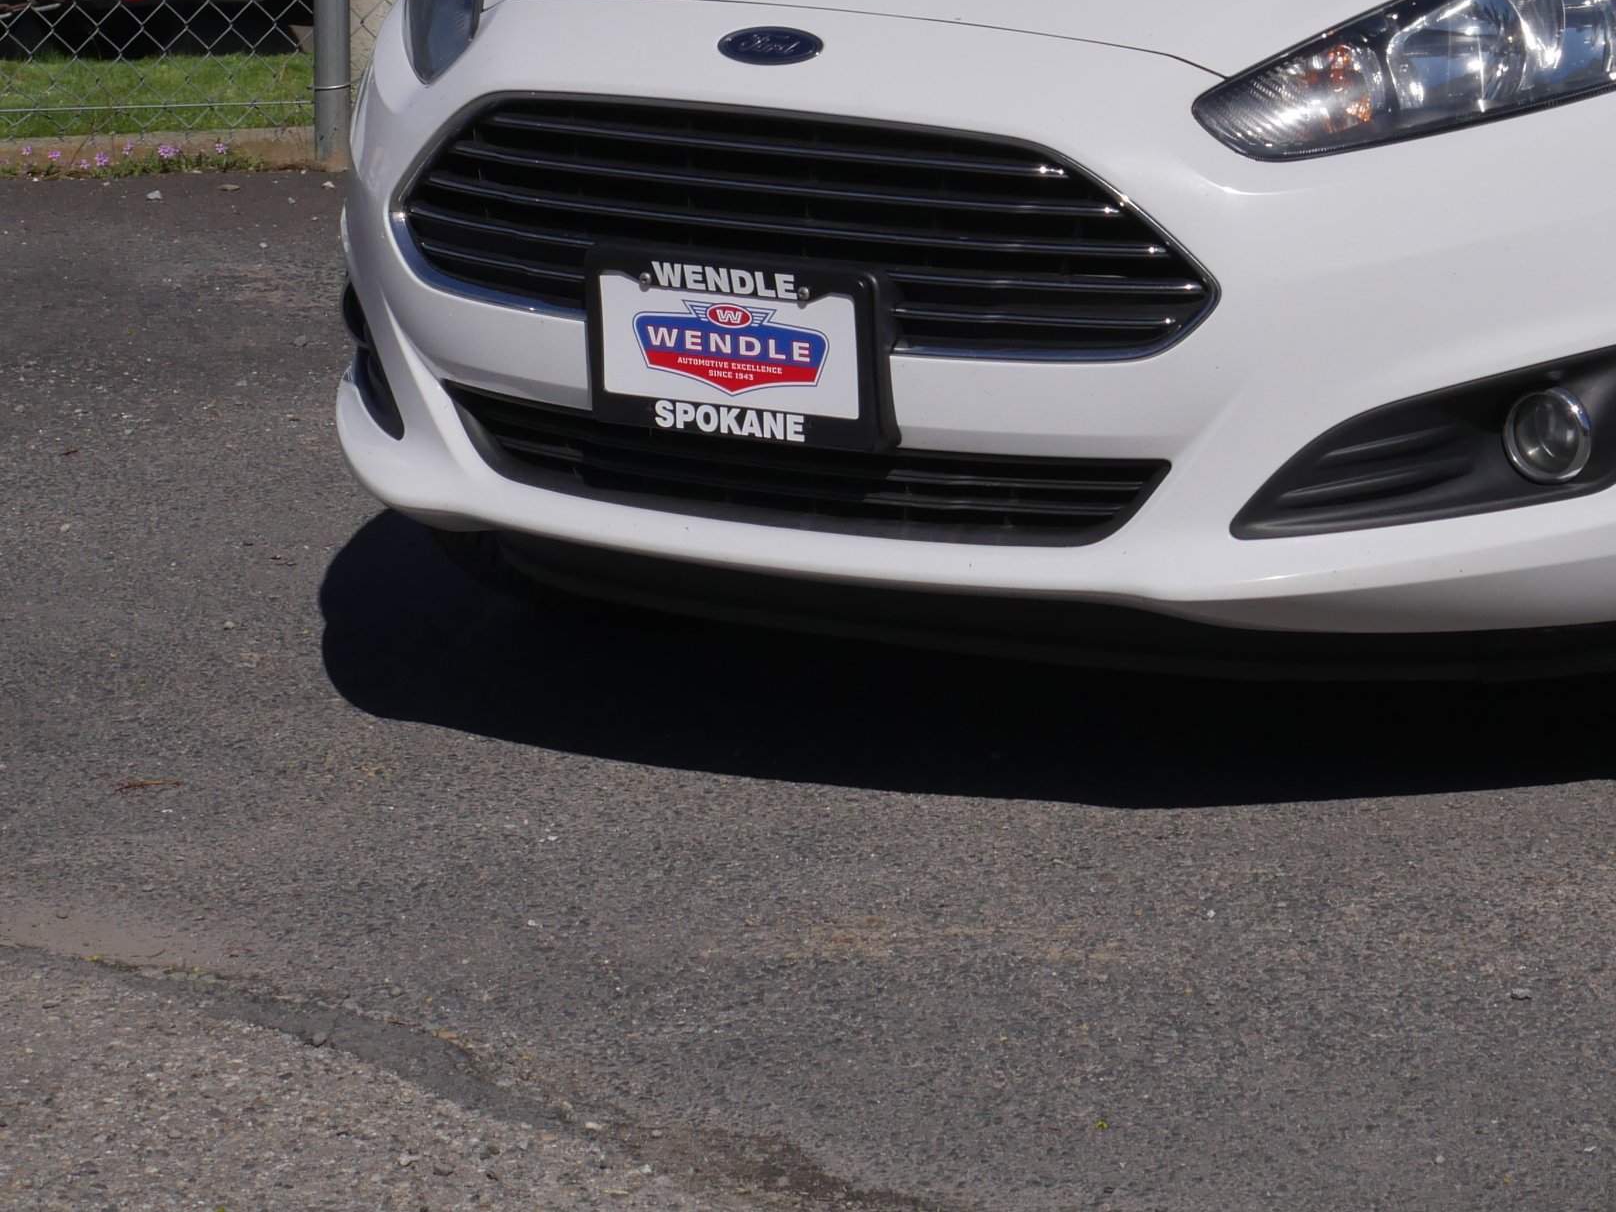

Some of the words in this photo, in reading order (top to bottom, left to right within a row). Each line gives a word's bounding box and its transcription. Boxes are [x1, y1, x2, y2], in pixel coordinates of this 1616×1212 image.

[652, 261, 798, 300] WENDLE
[647, 325, 811, 362] WENDLE
[677, 356, 729, 369] AUTOMOTIVE
[731, 362, 783, 374] EXCELLENCE
[708, 369, 733, 379] SINCE
[735, 372, 754, 381] 1943
[654, 400, 805, 442] SPOKANE
